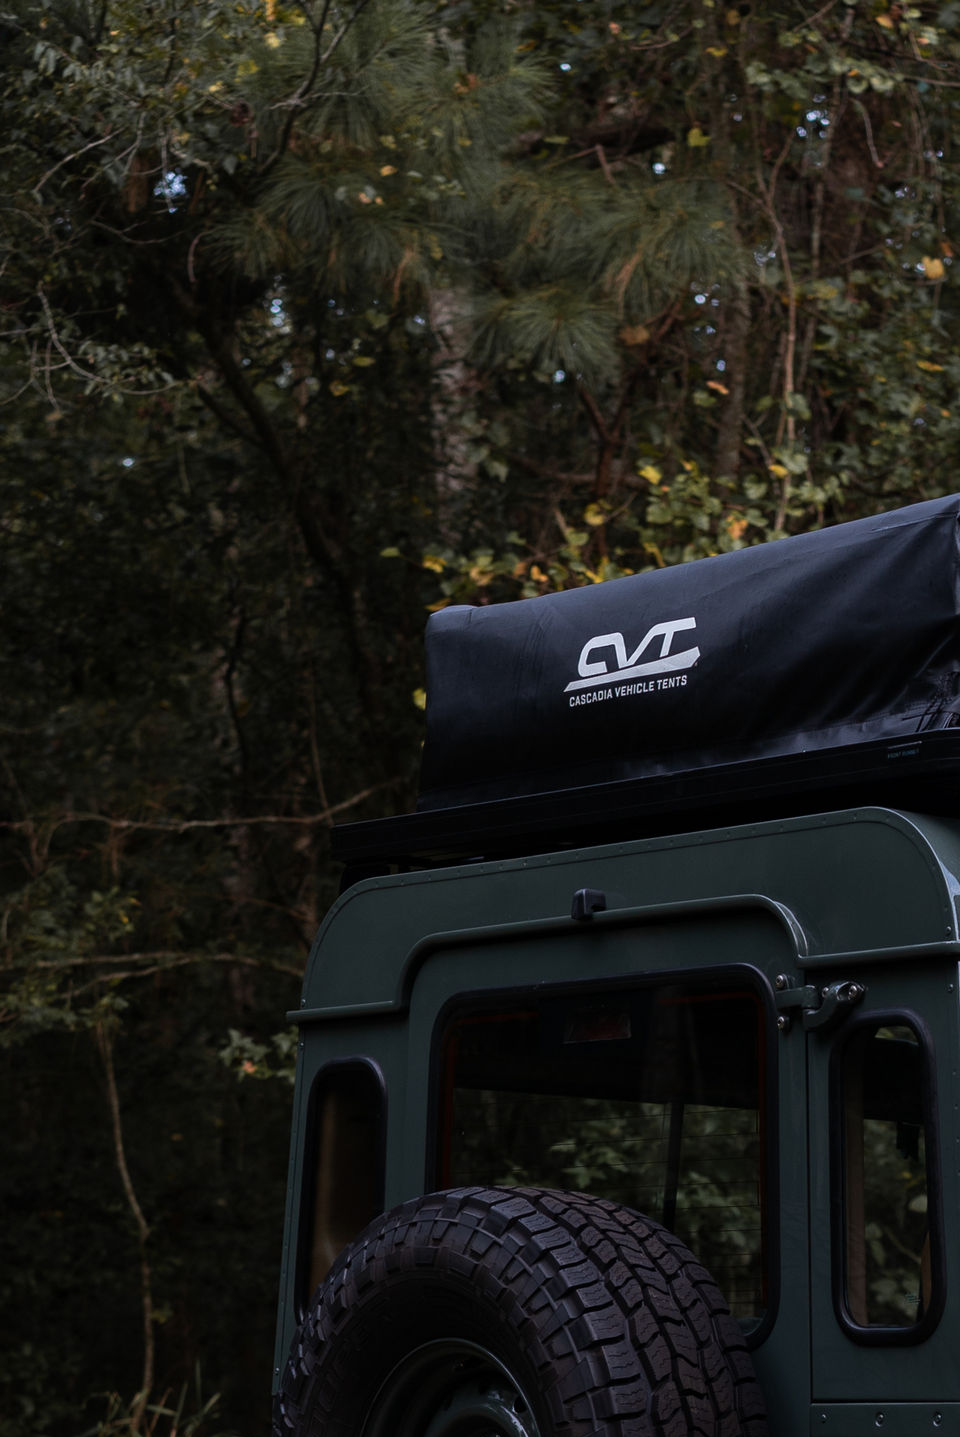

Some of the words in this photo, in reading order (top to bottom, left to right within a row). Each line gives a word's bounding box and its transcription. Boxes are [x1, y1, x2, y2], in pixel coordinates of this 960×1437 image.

[569, 688, 613, 707] CASCADIA
[614, 681, 655, 698] VEHICLE
[656, 675, 688, 691] TENTS
